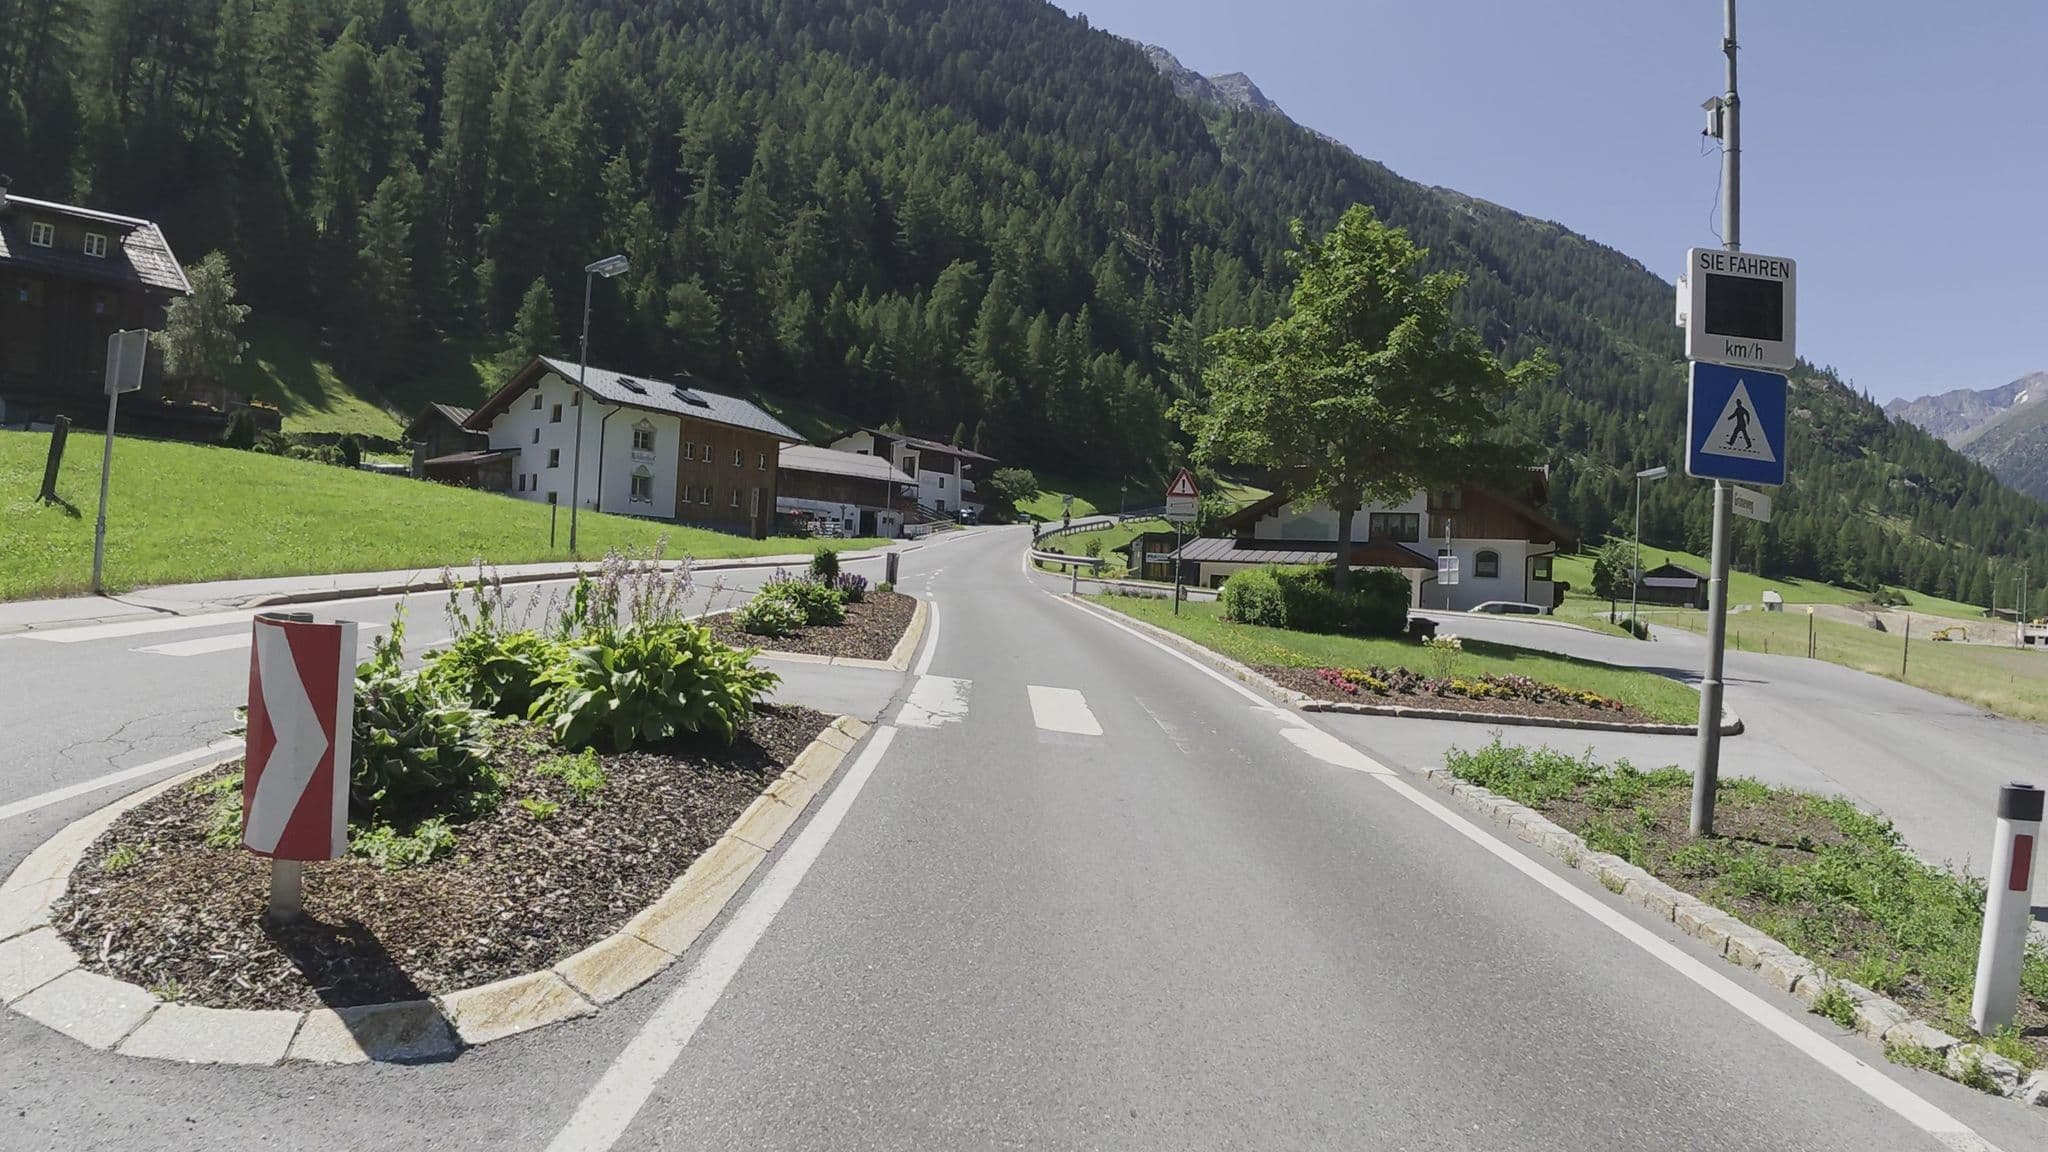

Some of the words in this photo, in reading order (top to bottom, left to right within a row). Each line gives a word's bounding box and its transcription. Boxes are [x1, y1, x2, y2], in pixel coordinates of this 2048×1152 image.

[1700, 253, 1724, 271] SIE
[1729, 256, 1789, 279] FAHREN
[1725, 340, 1763, 360] km/h
